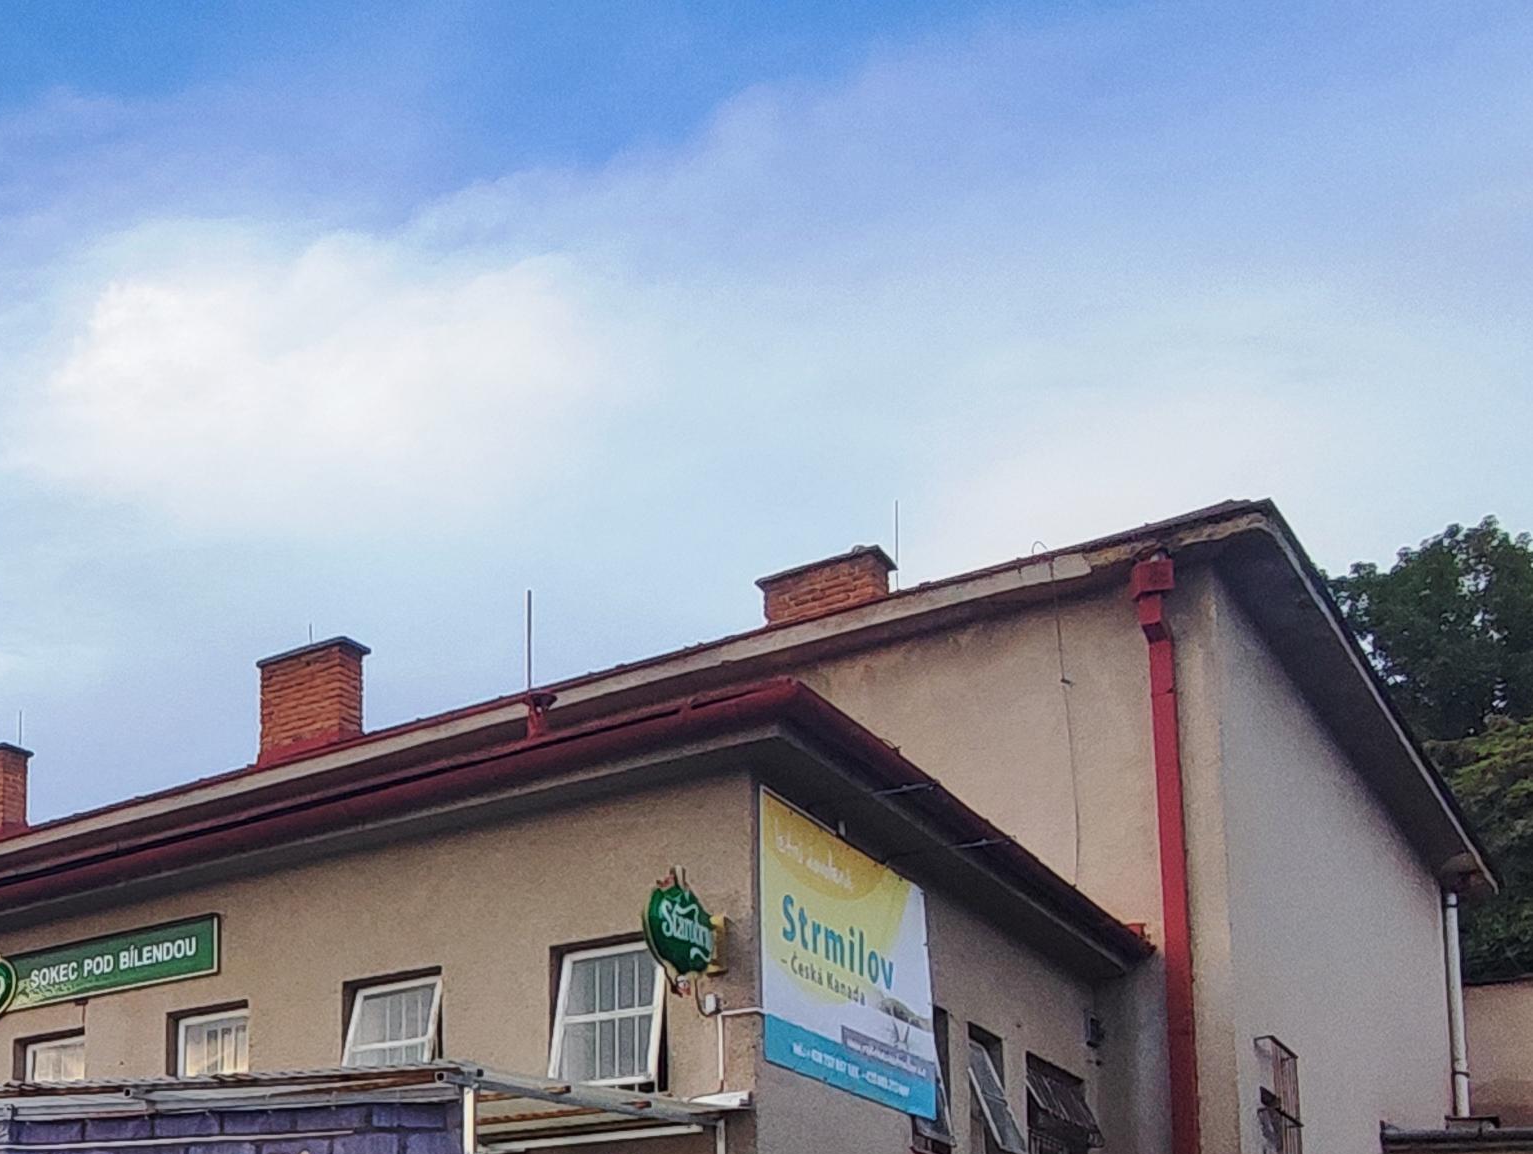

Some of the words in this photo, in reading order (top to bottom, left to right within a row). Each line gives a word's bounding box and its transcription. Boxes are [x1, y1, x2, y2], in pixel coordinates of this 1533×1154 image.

[30, 962, 78, 988] SOKEC
[83, 955, 114, 978] POD
[119, 936, 197, 970] BÍLENDOU
[781, 894, 894, 991] Strmilov
[790, 950, 824, 987] Česká
[826, 970, 866, 1006] Kanada
